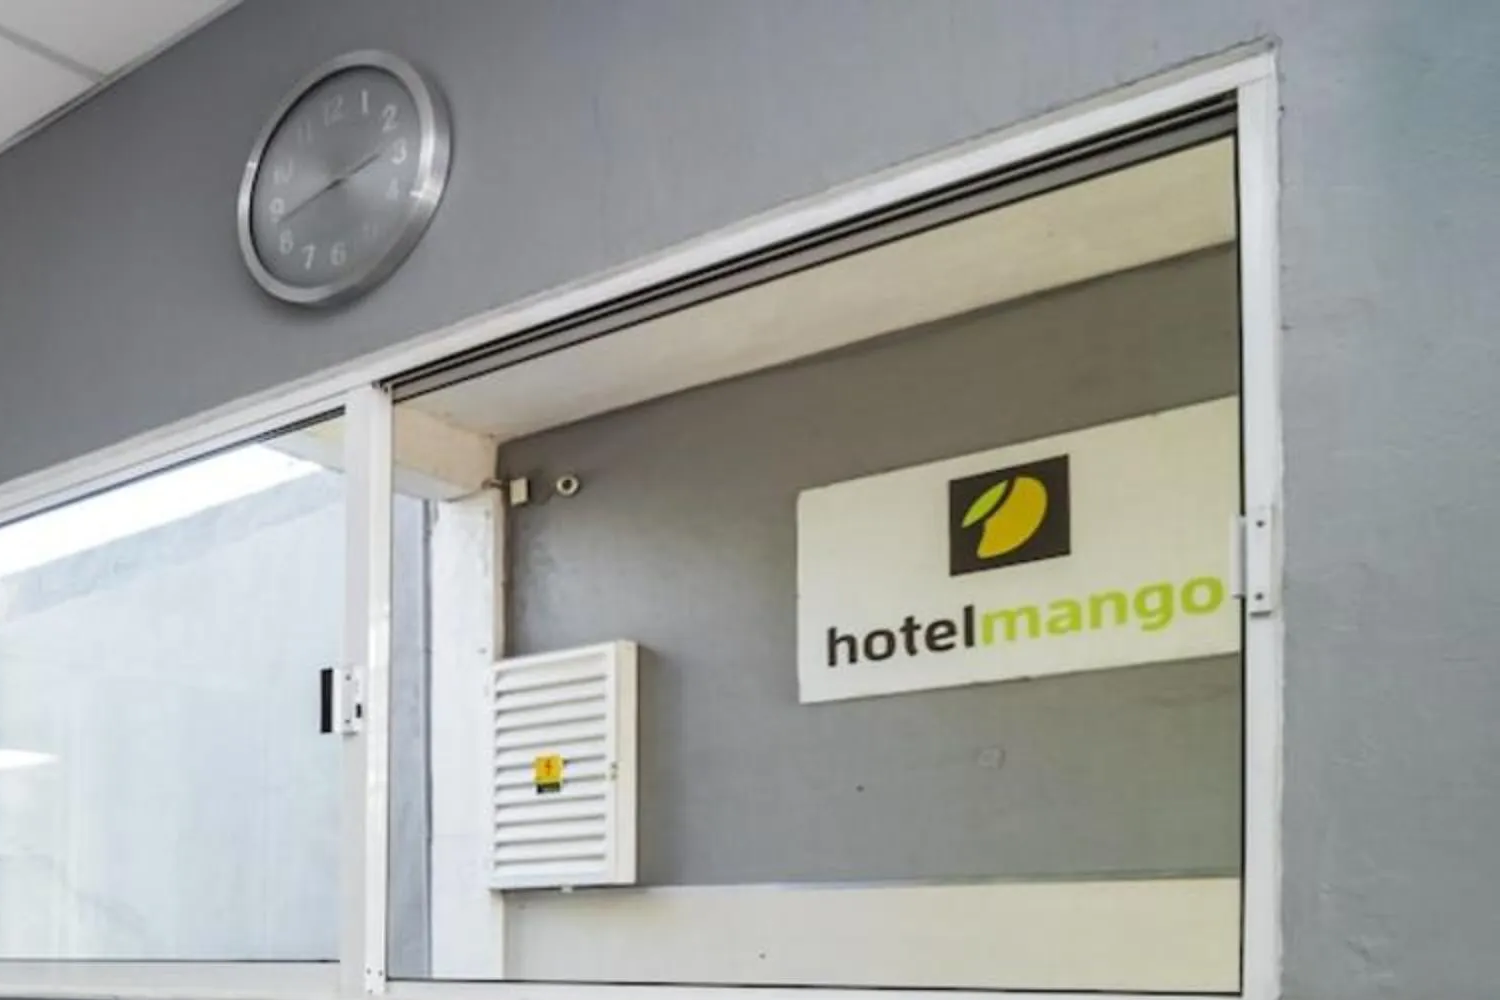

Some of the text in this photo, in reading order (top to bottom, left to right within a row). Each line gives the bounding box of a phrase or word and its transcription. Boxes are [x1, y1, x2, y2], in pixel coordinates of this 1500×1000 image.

[323, 93, 345, 128] 12
[360, 88, 370, 117] 1
[381, 103, 399, 133] 2
[390, 137, 408, 166] 3
[268, 197, 285, 224] 9
[279, 228, 294, 256] 8
[301, 242, 316, 271] 7
[329, 240, 347, 267] 6
[827, 576, 1224, 667] hotelmango
